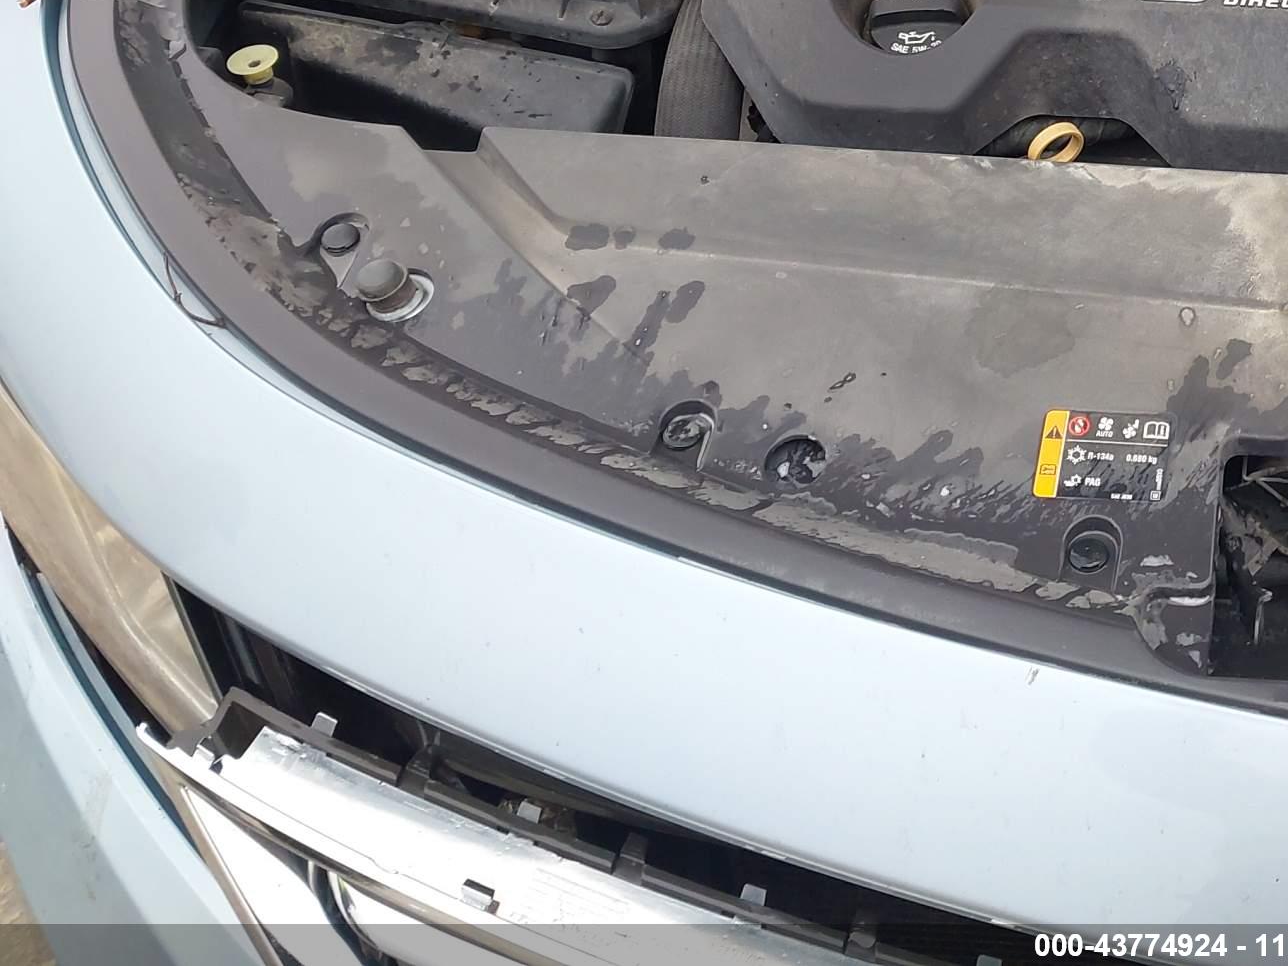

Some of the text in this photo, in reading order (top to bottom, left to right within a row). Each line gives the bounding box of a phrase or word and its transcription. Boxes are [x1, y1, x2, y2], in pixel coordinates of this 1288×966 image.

[890, 42, 910, 54] SAE
[1095, 430, 1114, 438] AUTO
[1084, 477, 1101, 487] PAG
